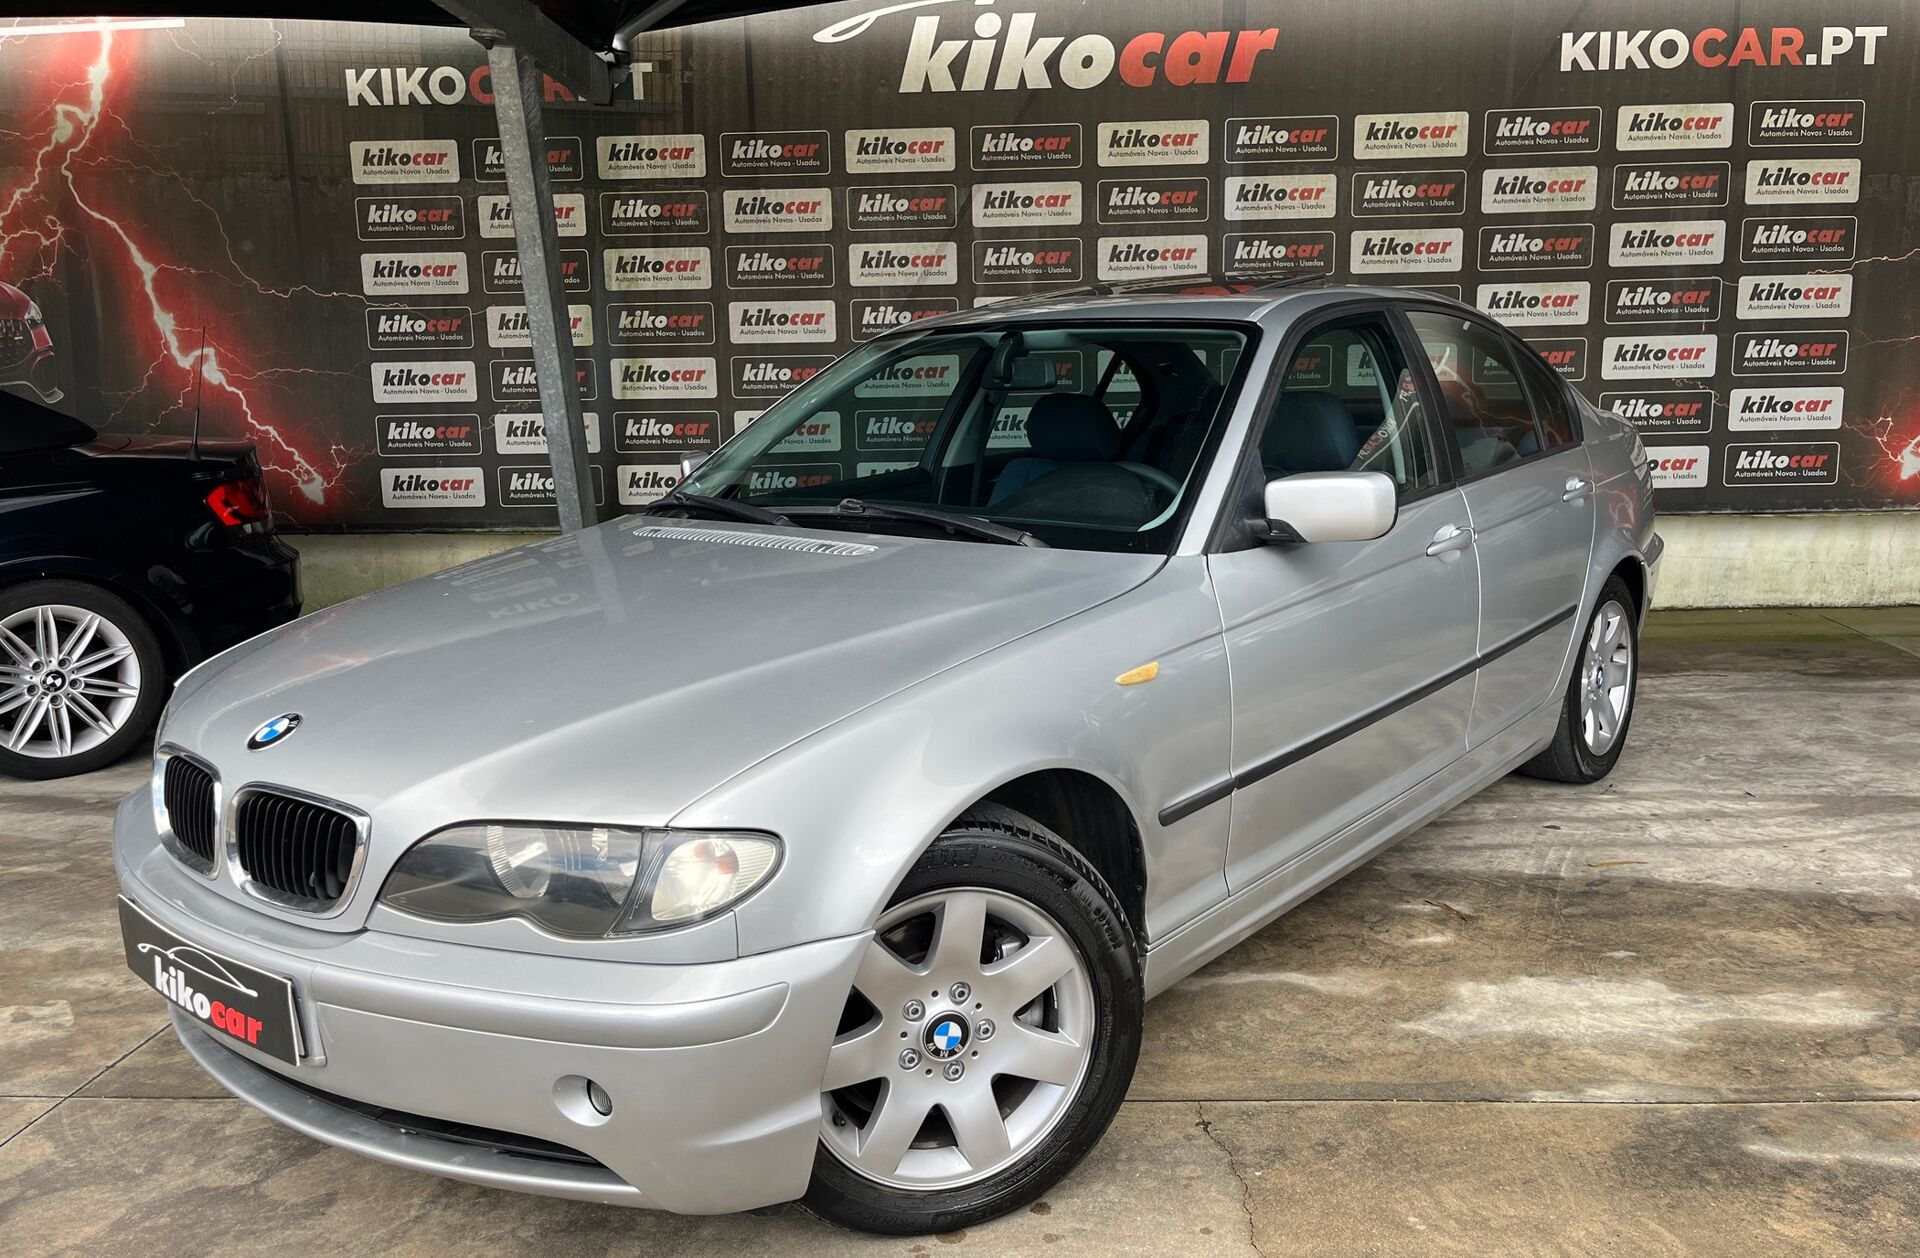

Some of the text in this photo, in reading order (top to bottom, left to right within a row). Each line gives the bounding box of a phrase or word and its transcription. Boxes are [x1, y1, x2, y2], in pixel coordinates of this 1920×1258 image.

[898, 12, 1280, 93] kikocar
[1559, 26, 1888, 72] KIKOCAR.PT
[1495, 116, 1590, 138] kikocar
[1627, 111, 1724, 133] kikocar
[1760, 107, 1854, 129] kikocar
[1108, 128, 1200, 149] kikocar
[1236, 124, 1328, 146] kikocar
[1365, 120, 1459, 142] kikocar
[1494, 135, 1589, 147] Automóveis Novos Usados
[1759, 127, 1853, 137] Automóveis Novos Usados
[608, 142, 695, 162] kikocar
[731, 139, 820, 159] kikocar
[856, 135, 945, 156] kikocar
[982, 131, 1072, 153] kikocar
[1235, 143, 1328, 155] Automóveis Novos Usados
[362, 148, 449, 168] kikocar
[731, 158, 820, 168] Automóveis Novos Usados
[981, 151, 1072, 162] Automóveis Novos Usados
[1493, 174, 1587, 196] kikocar
[1624, 170, 1719, 192] kikocar
[1757, 166, 1850, 187] kikocar
[1108, 185, 1199, 207] kikocar
[1235, 182, 1327, 203] kikocar
[1363, 178, 1456, 200] kikocar
[1623, 190, 1718, 201] Automóveis Novos Usados
[611, 198, 698, 219] kikocar
[734, 195, 822, 216] kikocar
[858, 192, 947, 213] kikocar
[982, 189, 1072, 210] kikocar
[1362, 198, 1455, 209] Automóveis Novos Usados
[367, 204, 453, 223] kikocar
[857, 212, 947, 222] Automóveis Novos Usados
[1107, 205, 1198, 216] Automóveis Novos Usados
[367, 223, 455, 232] Automóveis Novos Usados
[611, 218, 648, 227] Automóveis
[675, 218, 699, 226] Usados
[1490, 232, 1583, 253] kikocar
[1620, 228, 1715, 250] kikocar
[1752, 224, 1846, 245] kikocar
[983, 246, 1073, 266] kikocar
[1108, 243, 1198, 263] kikocar
[1234, 239, 1325, 260] kikocar
[1361, 236, 1454, 257] kikocar
[1489, 251, 1582, 262] Automóveis Novos Usados
[1751, 244, 1845, 254] Automóveis Novos Usados
[372, 259, 458, 279] kikocar
[615, 254, 701, 274] kikocar
[737, 252, 824, 272] kikocar
[859, 249, 948, 269] kikocar
[1173, 262, 1198, 271] Usados
[1233, 258, 1325, 269] Automóveis Novos Usados
[736, 271, 825, 281] Automóveis Novos Usados
[983, 265, 1072, 275] Automóveis Novos Usados
[1487, 289, 1580, 310] kikocar
[1617, 285, 1711, 306] kikocar
[1748, 281, 1842, 302] kikocar
[1616, 305, 1709, 315] Automóveis Novos Usados
[1815, 301, 1841, 309] Usados
[377, 314, 462, 333] kikocar
[618, 310, 704, 329] kikocar
[739, 307, 826, 327] kikocar
[378, 333, 414, 342] Automóveis
[440, 333, 464, 341] Usados
[618, 329, 655, 338] Automóveis
[681, 329, 705, 337] Usados
[802, 326, 827, 335] Usados
[1613, 342, 1707, 362] kikocar
[1744, 338, 1838, 359] kikocar
[742, 363, 818, 382] kikoca
[1680, 361, 1705, 369] Usados
[1742, 359, 1782, 367] Automóveis
[1811, 358, 1836, 366] Usados
[382, 368, 466, 387] kikocar
[621, 364, 707, 383] kikocar
[1611, 398, 1703, 418] kikocar
[1739, 394, 1833, 414] kikocar
[1806, 413, 1832, 421] Usados
[387, 421, 470, 440] kikocar
[623, 419, 710, 437] kikocar
[387, 440, 423, 448] Automóveis
[448, 439, 472, 447] Usados
[624, 436, 711, 445] Automóveis Novos Usados
[1735, 450, 1829, 468] kikocar
[391, 474, 474, 492] kikocar
[1734, 468, 1828, 478] Automóveis Novos Usados
[154, 955, 262, 1045] kikocar
